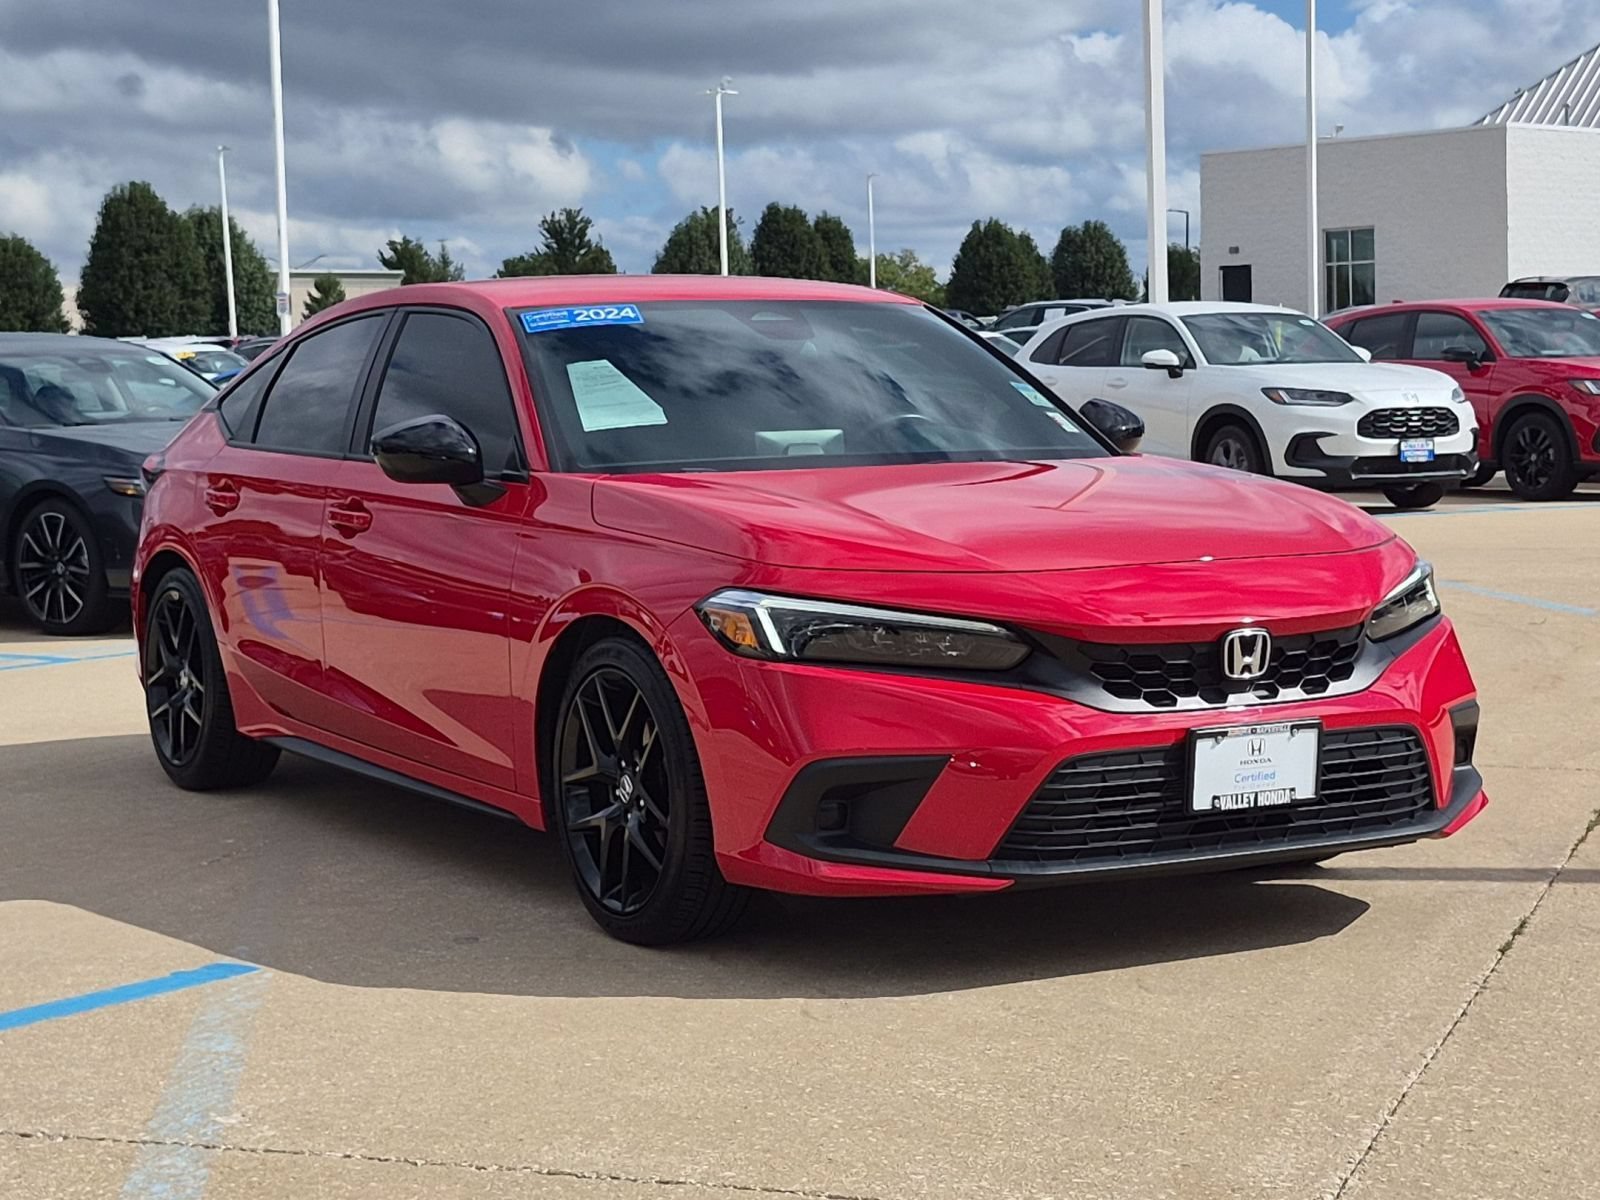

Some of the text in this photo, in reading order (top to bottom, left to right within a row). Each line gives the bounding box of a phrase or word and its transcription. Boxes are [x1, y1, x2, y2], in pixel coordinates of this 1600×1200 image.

[574, 308, 635, 321] 2024
[1239, 758, 1272, 766] HONDA
[1235, 771, 1276, 784] Certified
[1220, 789, 1291, 811] VALLEY HONDA
